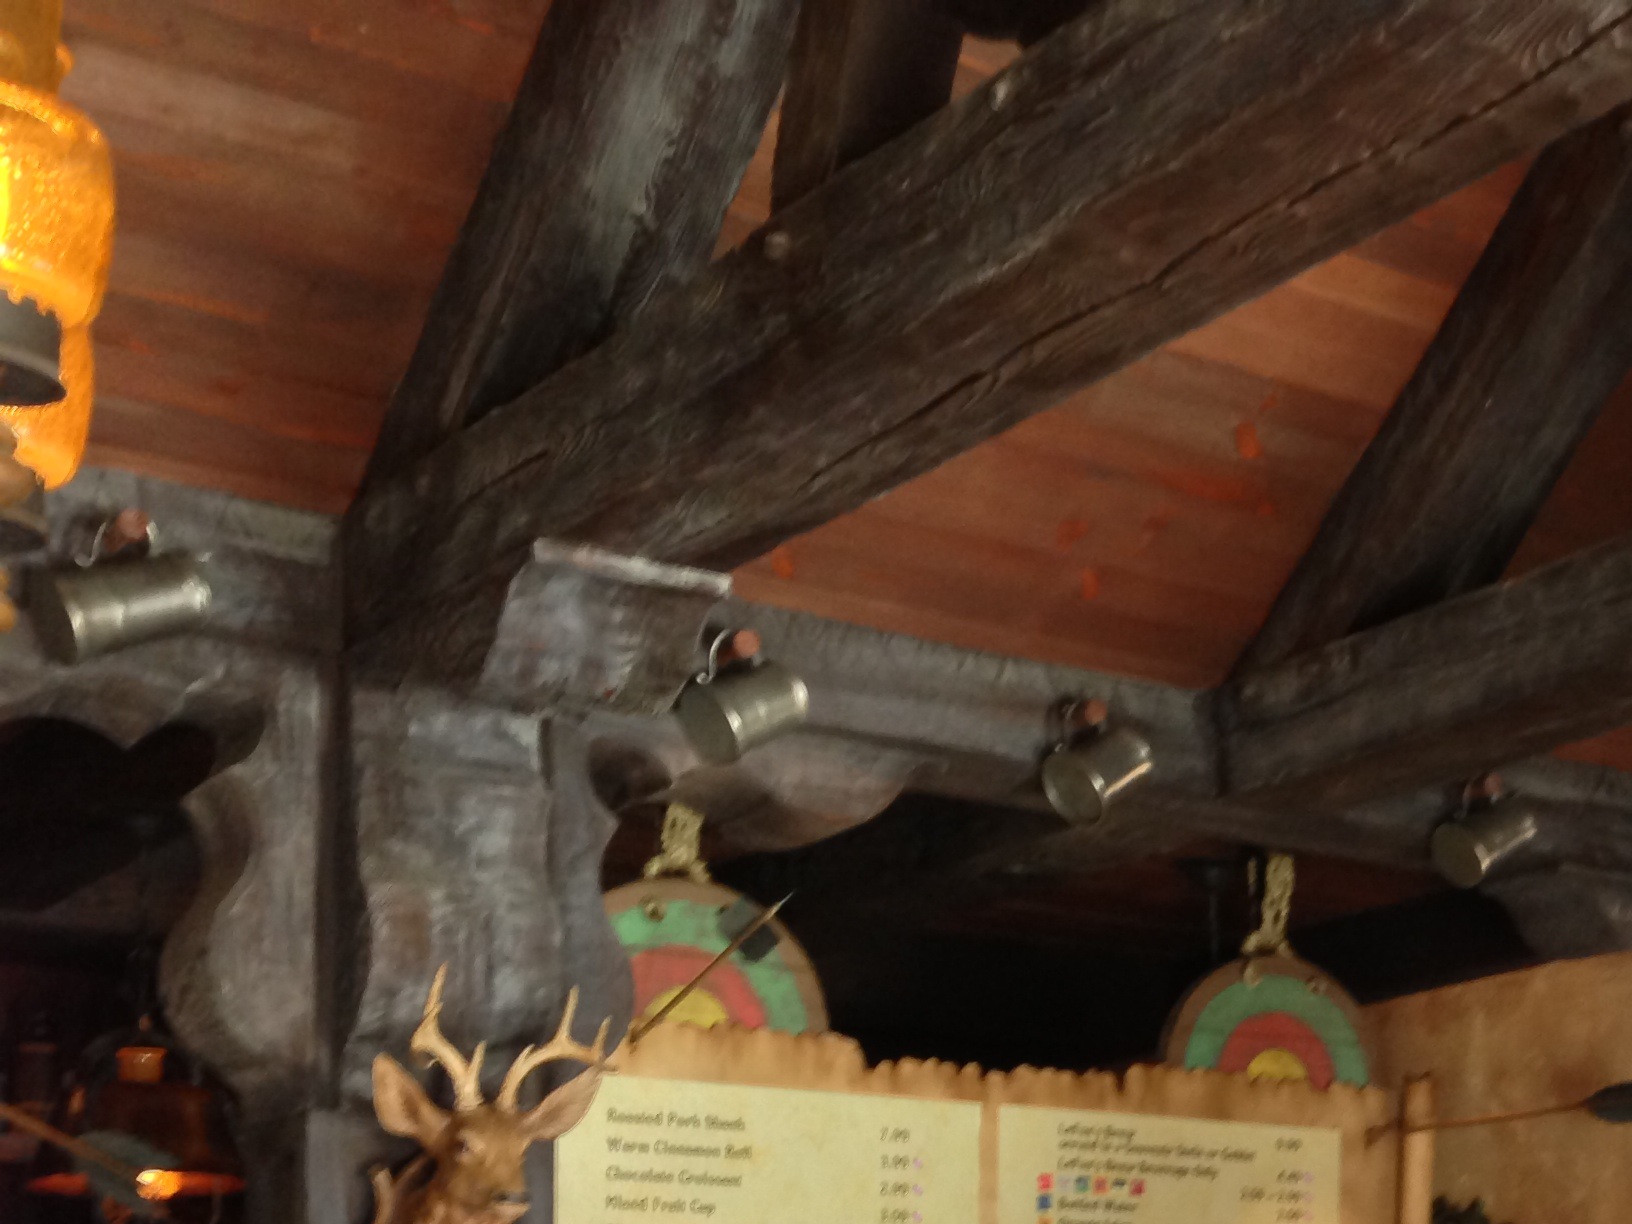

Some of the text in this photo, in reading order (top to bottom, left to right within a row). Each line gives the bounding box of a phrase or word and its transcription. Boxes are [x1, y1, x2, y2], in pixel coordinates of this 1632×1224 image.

[606, 1136, 650, 1153] Warm
[653, 1139, 721, 1158] Cinnamon
[605, 1164, 674, 1184] Chocolate
[652, 1196, 687, 1213] Fruit
[689, 1198, 717, 1218] Cup
